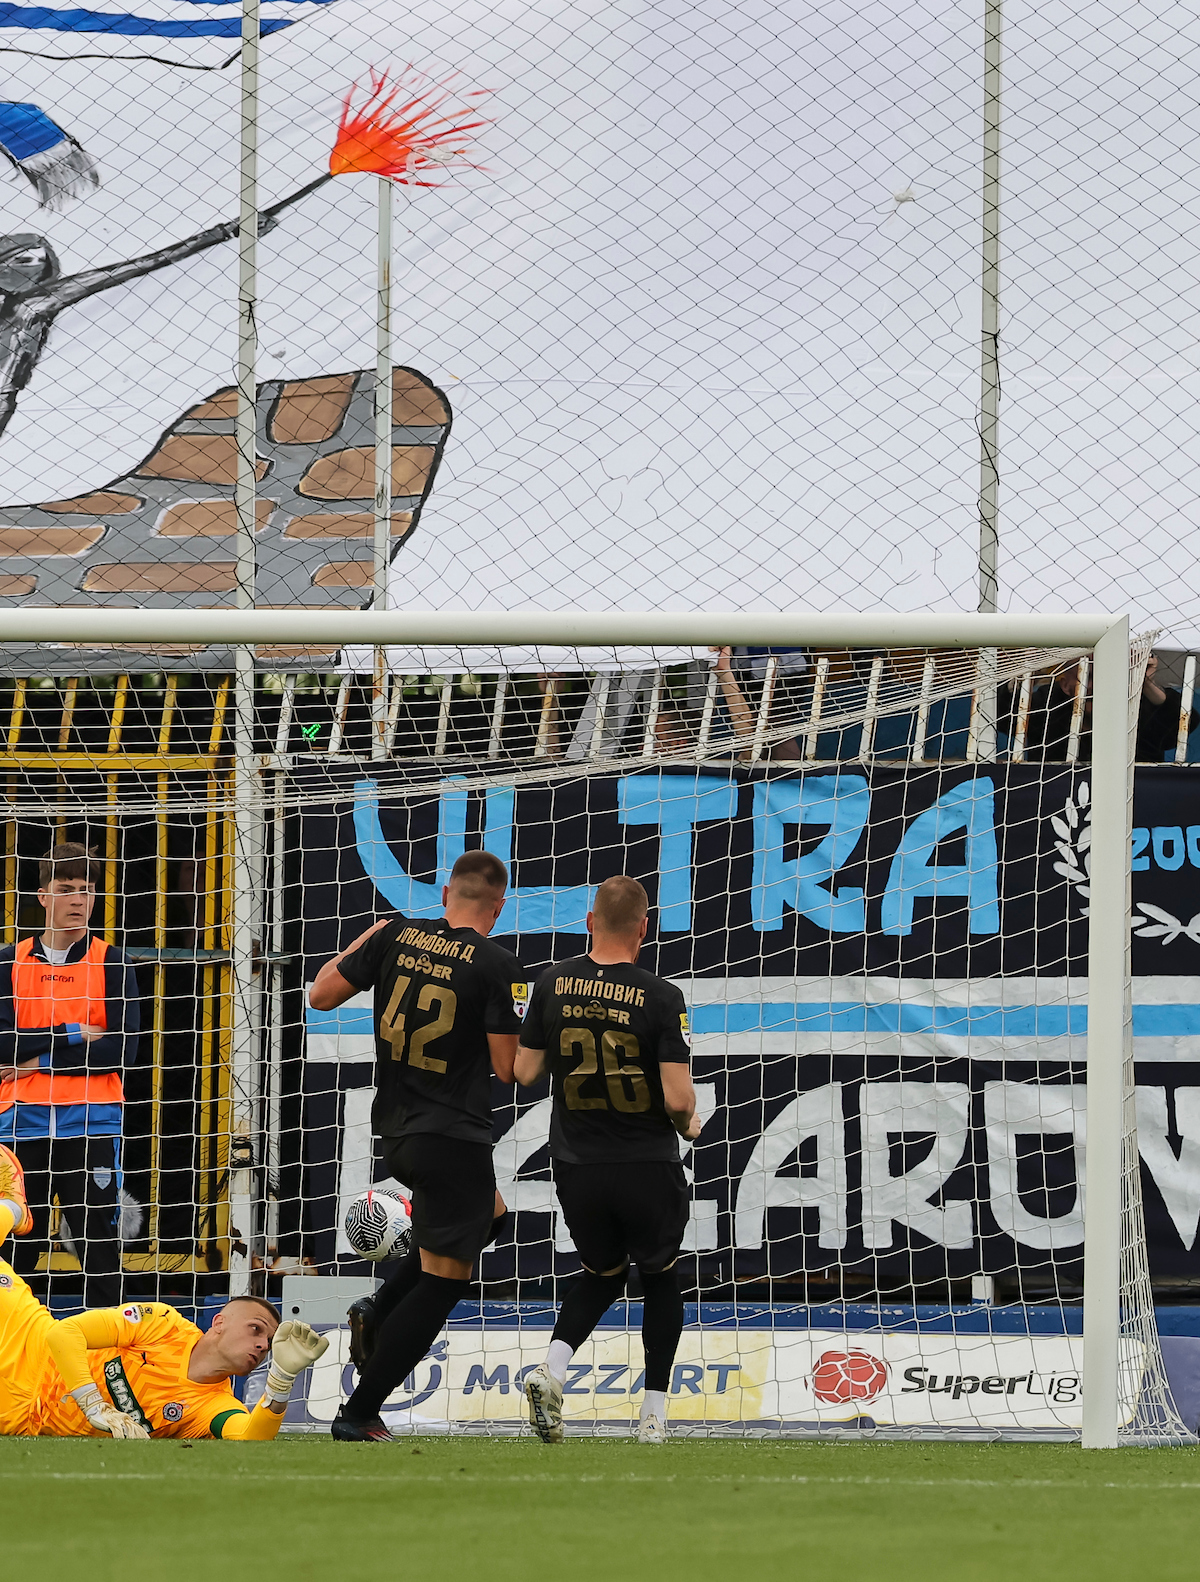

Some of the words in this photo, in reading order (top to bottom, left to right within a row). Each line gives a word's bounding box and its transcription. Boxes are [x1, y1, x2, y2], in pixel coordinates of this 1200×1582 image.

[353, 774, 1001, 937] ULTRA
[555, 976, 645, 1007] ФИЛИПОВИЋ
[561, 1000, 631, 1026] SOCCER
[380, 975, 457, 1075] 42
[560, 1027, 651, 1114] 26
[900, 1366, 1083, 1403] SuperLig
